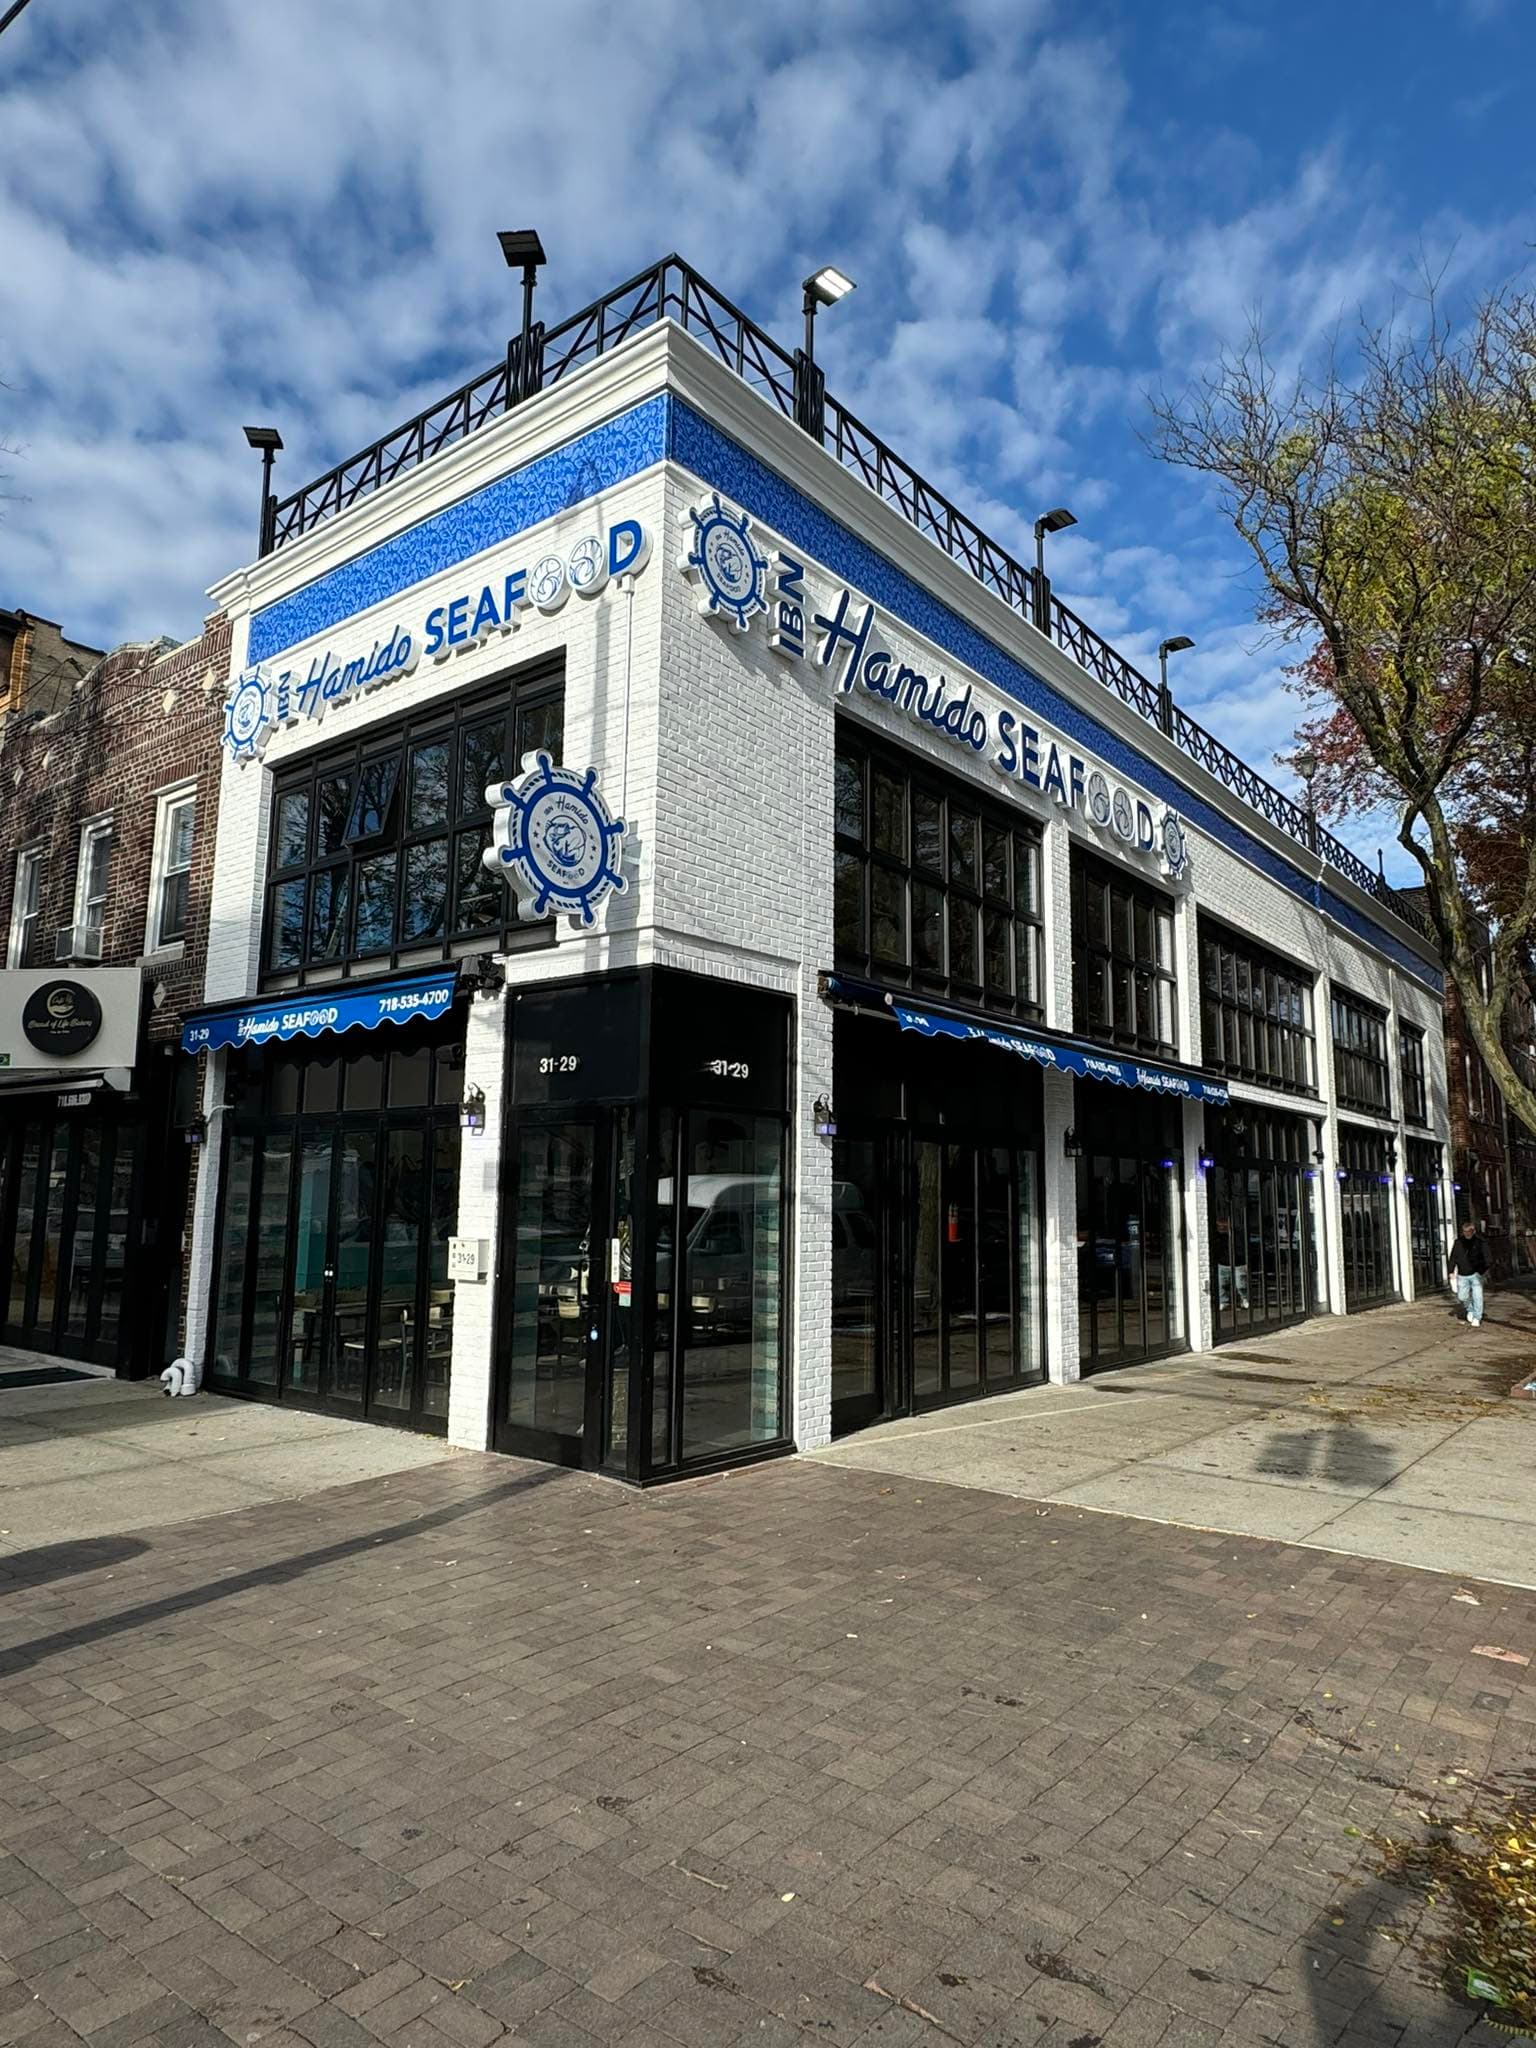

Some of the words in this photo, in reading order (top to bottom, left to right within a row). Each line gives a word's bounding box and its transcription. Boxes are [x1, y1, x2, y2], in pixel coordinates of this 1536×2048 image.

[277, 670, 291, 721] IBN
[296, 624, 412, 718] Hamido
[424, 519, 643, 656] SEAFOOD
[778, 551, 804, 658] IBN
[813, 589, 987, 751] Hamido
[997, 710, 1154, 851] SEAFOOD
[555, 794, 589, 825] Hamido
[546, 860, 585, 880] SEAFOOD
[189, 1028, 210, 1042] 31-29
[242, 1016, 280, 1039] Hamido
[281, 1007, 338, 1030] SEAFOOD
[379, 988, 449, 1014] 718-535-4700
[539, 1055, 577, 1074] 31-29
[710, 1059, 749, 1079] 31-29
